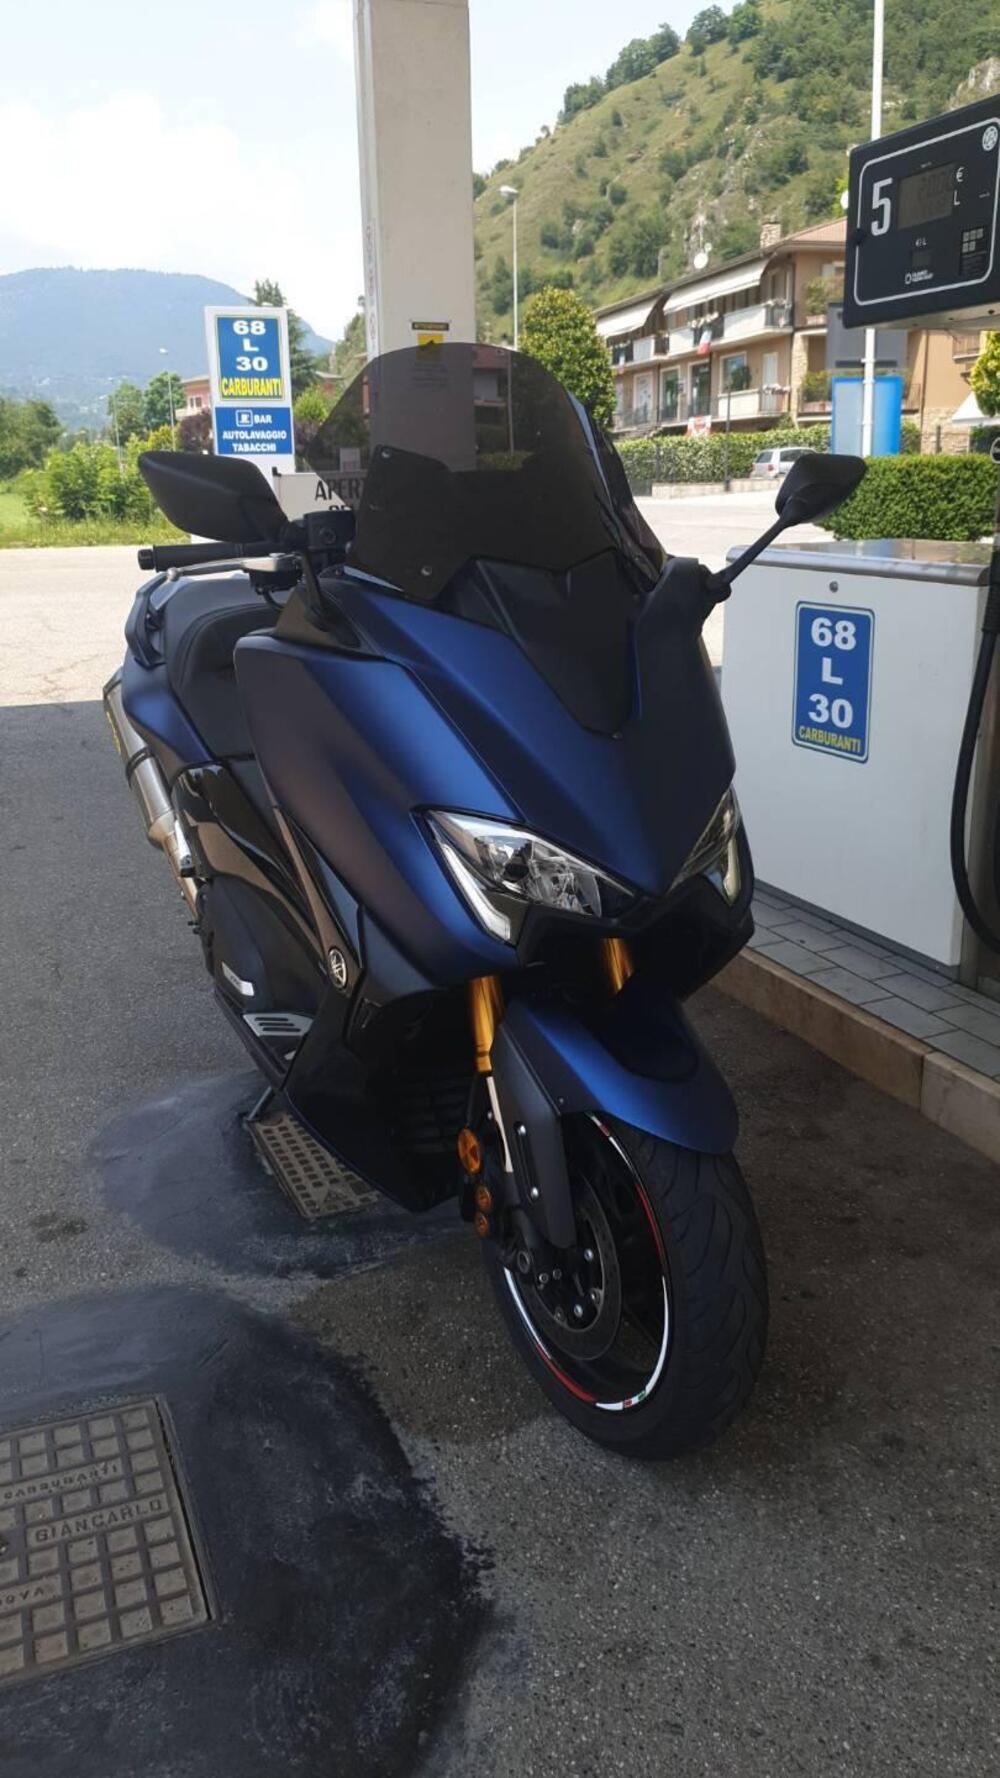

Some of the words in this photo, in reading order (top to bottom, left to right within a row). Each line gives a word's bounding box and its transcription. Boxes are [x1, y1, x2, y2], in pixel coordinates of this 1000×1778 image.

[953, 190, 961, 205] L
[871, 177, 893, 236] 5
[233, 320, 266, 335] 68
[243, 339, 259, 352] L
[236, 357, 268, 371] 30
[221, 378, 283, 396] CARBURANTI
[254, 414, 272, 424] BAR
[222, 430, 287, 440] AUTOLAVAGGIO
[232, 443, 277, 452] TABACCHI
[811, 617, 857, 651] 68
[822, 657, 844, 685] L
[808, 693, 854, 729] 30
[799, 725, 861, 753] CARBURANTI
[35, 1500, 162, 1543] GIANCARLO
